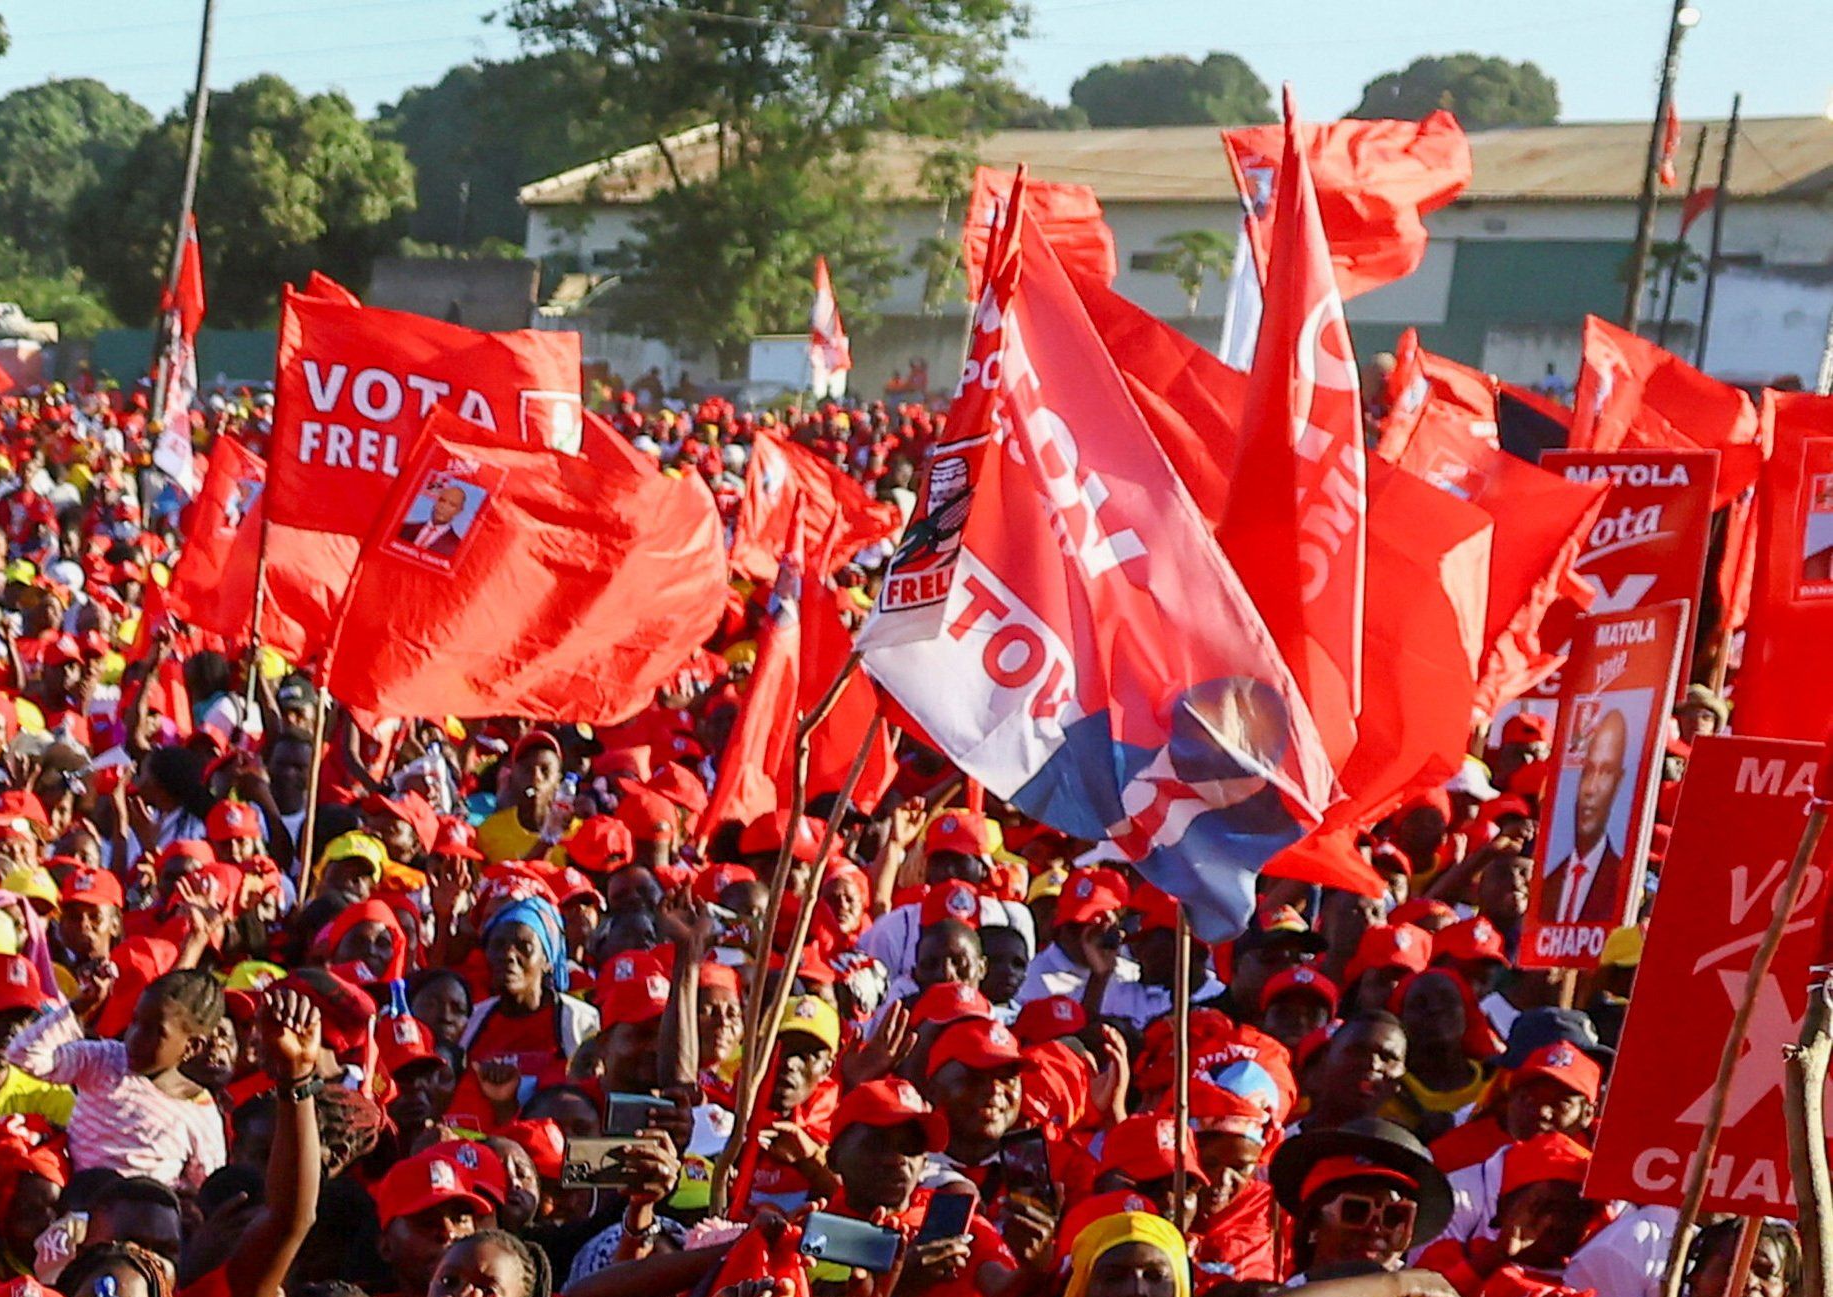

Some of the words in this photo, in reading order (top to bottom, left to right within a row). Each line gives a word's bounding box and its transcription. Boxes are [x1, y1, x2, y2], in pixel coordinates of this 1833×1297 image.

[302, 360, 497, 433] VOTA
[298, 421, 400, 478] FREL
[1565, 464, 1690, 487] MATOLA
[1590, 504, 1664, 547] ota
[886, 565, 955, 606] FREL
[1596, 620, 1656, 646] MATOLA
[1538, 926, 1605, 957] CHAPO
[1632, 1147, 1796, 1206] CHA
